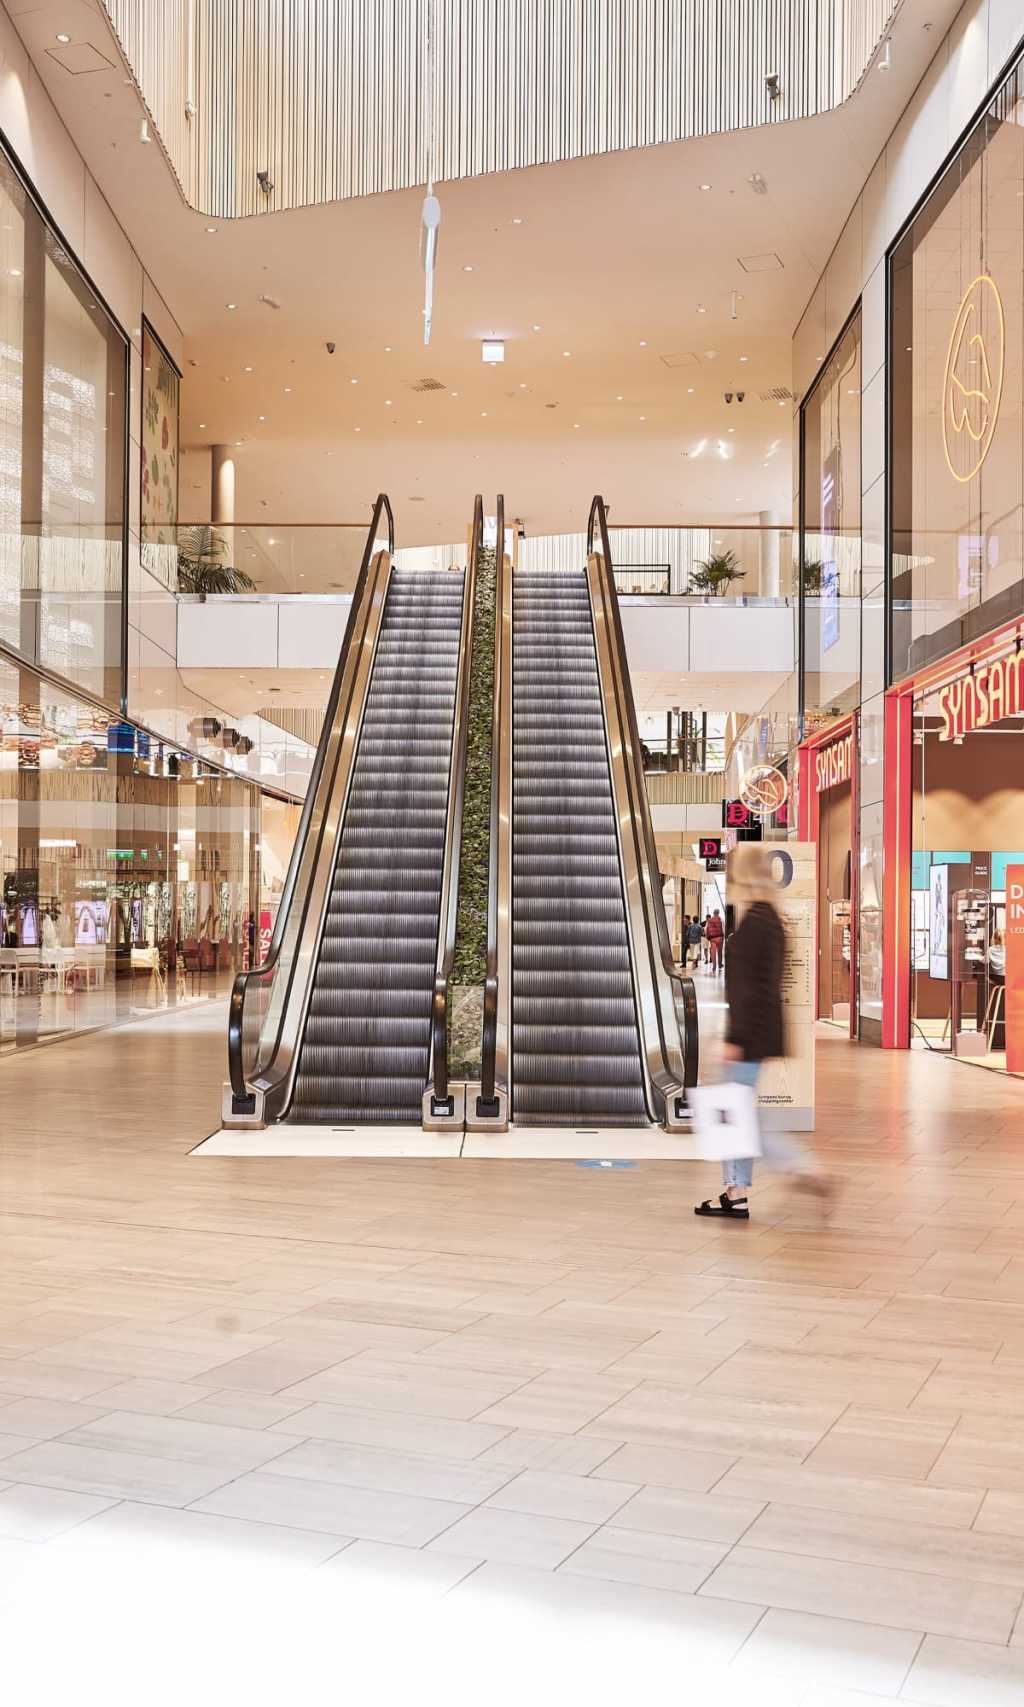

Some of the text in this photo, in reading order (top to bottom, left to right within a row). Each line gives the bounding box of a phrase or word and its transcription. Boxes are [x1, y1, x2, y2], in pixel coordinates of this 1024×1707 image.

[939, 652, 1024, 741] SYNSAM
[702, 840, 718, 855] D
[259, 928, 271, 967] SAL
